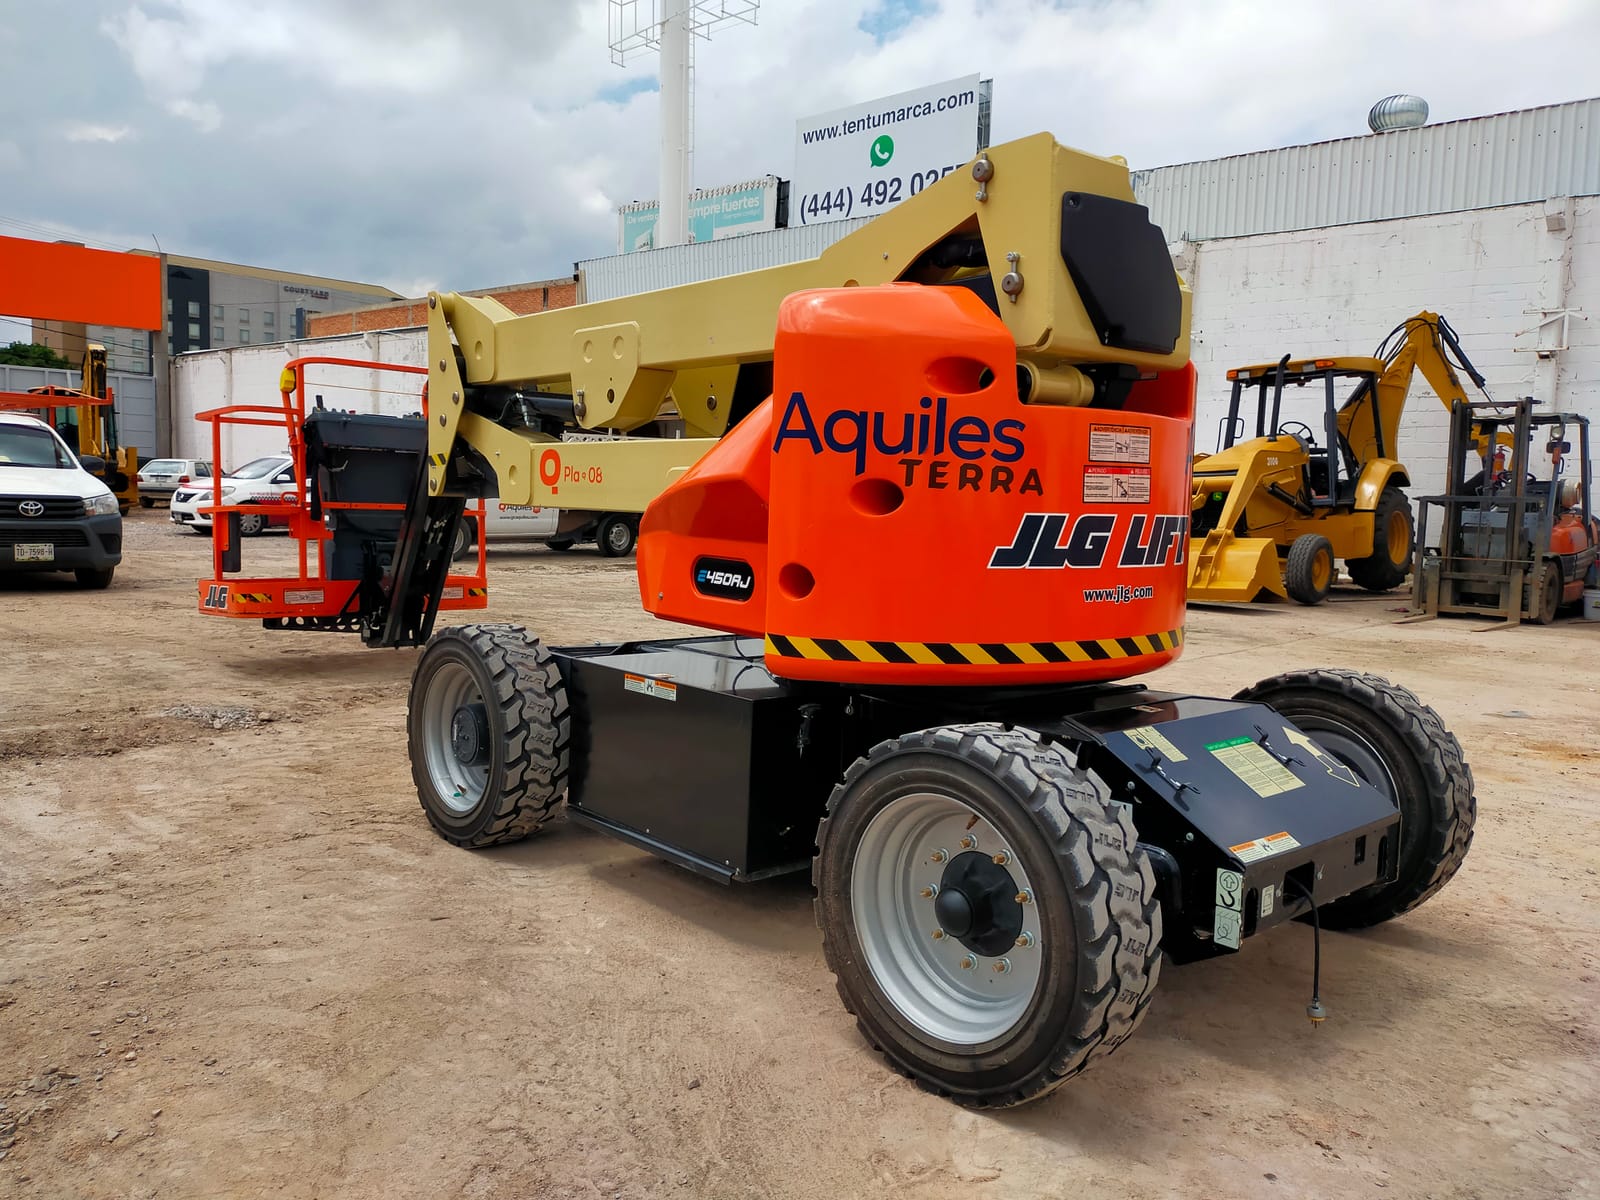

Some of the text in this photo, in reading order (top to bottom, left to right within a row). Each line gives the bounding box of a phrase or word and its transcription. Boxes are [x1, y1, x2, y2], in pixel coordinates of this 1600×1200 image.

[803, 90, 974, 144] www.tentumarca.com
[721, 195, 760, 213] fuertes
[800, 186, 853, 224] (444)
[860, 177, 902, 207] 492
[772, 391, 1026, 477] Aquiles
[898, 458, 1043, 497] TERRA
[986, 512, 1118, 569] JLG
[697, 569, 751, 589] E450AJ
[204, 584, 229, 609] JLG
[1083, 585, 1153, 604] www.jlg.com
[1095, 833, 1122, 851] JLG
[1123, 937, 1146, 957] JLG
